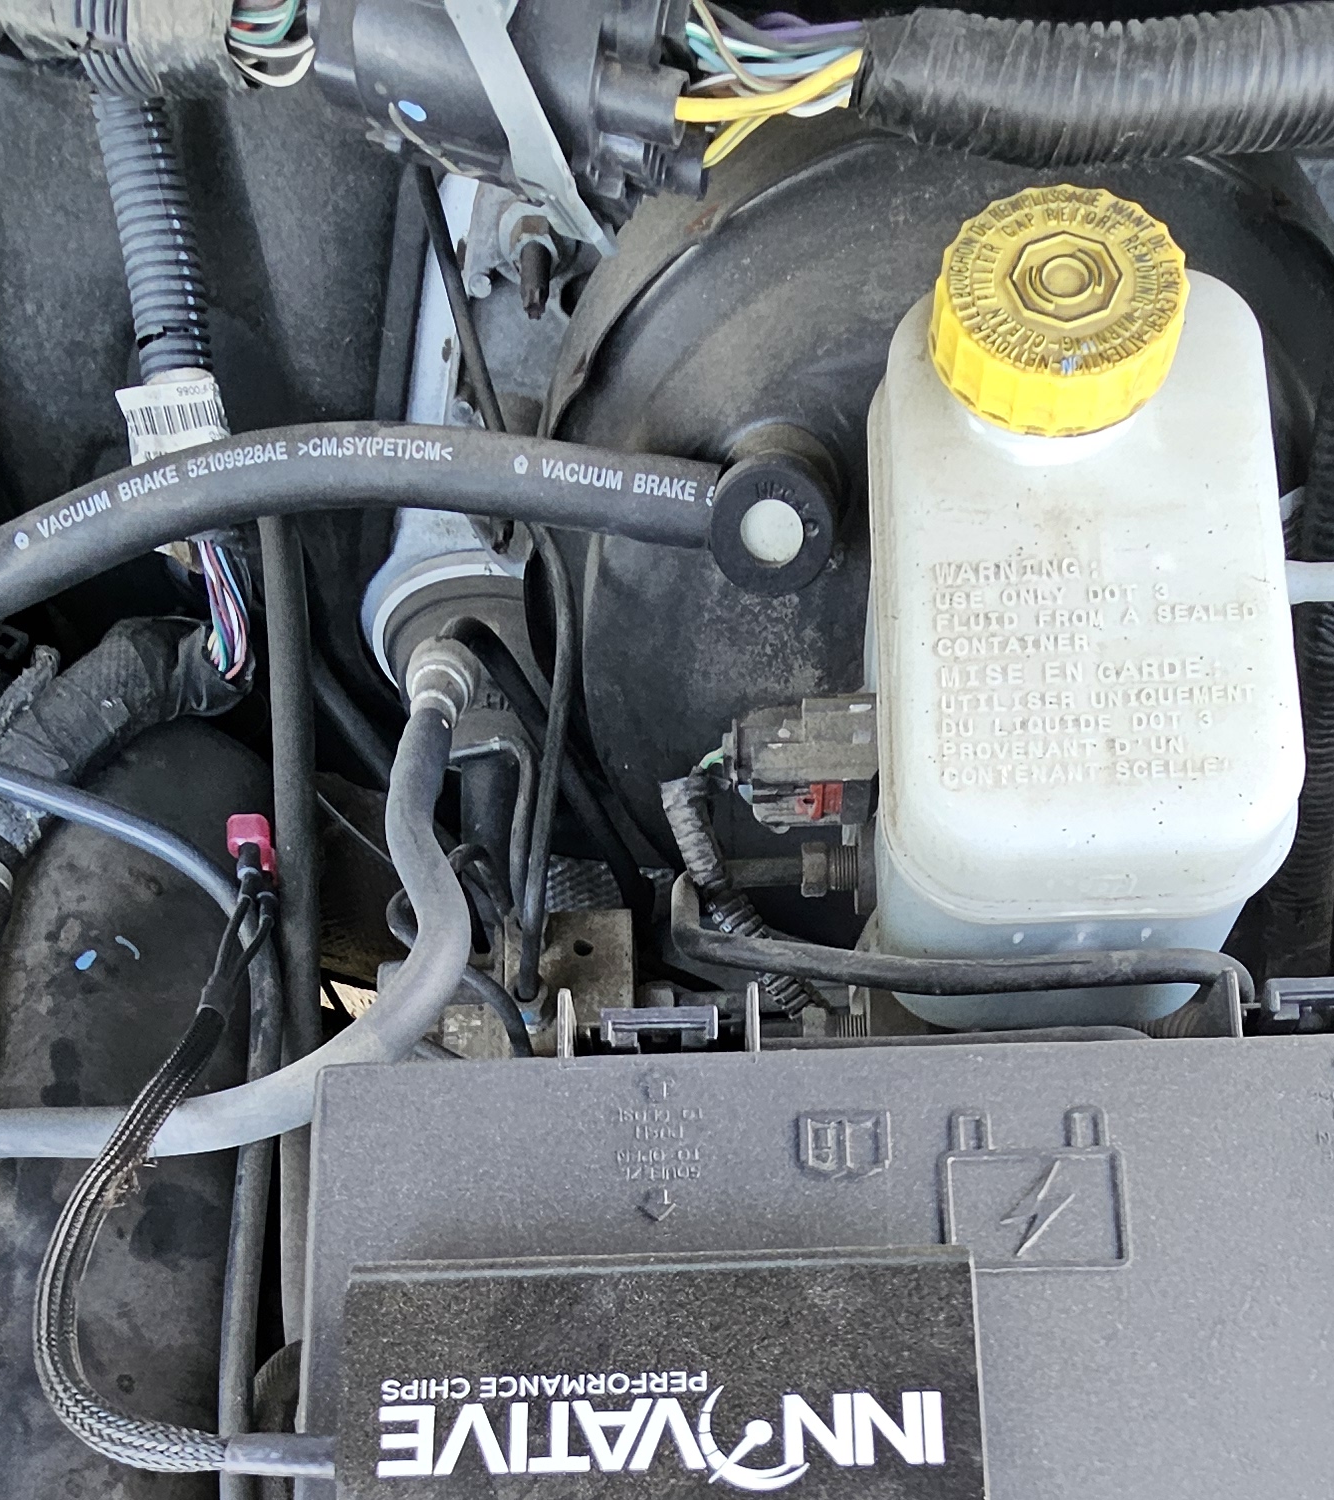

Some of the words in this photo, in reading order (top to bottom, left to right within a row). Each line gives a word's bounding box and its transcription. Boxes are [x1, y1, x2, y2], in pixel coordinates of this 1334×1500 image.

[973, 242, 1004, 304] FILLER
[1000, 213, 1035, 238] CAP
[1045, 206, 1123, 240] BEFORE
[36, 489, 112, 539] VACUUM
[117, 467, 179, 503] BRAKE
[187, 441, 288, 479] 52109928AE
[541, 458, 624, 491] VACUUM
[632, 473, 698, 502] BRAKE
[934, 589, 984, 610] USE
[1001, 586, 1066, 608] ONLY
[1087, 583, 1137, 604] DOT
[935, 612, 1019, 634] FLUID
[1036, 608, 1104, 628] FROM
[1121, 607, 1140, 625] A
[1156, 602, 1258, 624] SEALED
[935, 633, 1089, 657] CONTAINER
[940, 663, 1025, 688] MISE
[1045, 661, 1083, 683] EN
[941, 690, 1076, 713] UTILISER
[1090, 683, 1255, 709] UNIQUEMENT
[941, 717, 974, 737] DU
[993, 713, 1112, 737] LIQUIDE
[1132, 711, 1182, 732] DOT
[941, 740, 1099, 761] PROVENANT
[942, 764, 1099, 786] CONTENANT
[380, 1377, 471, 1402] CHIPS
[479, 1369, 709, 1396] PERFORMANCE
